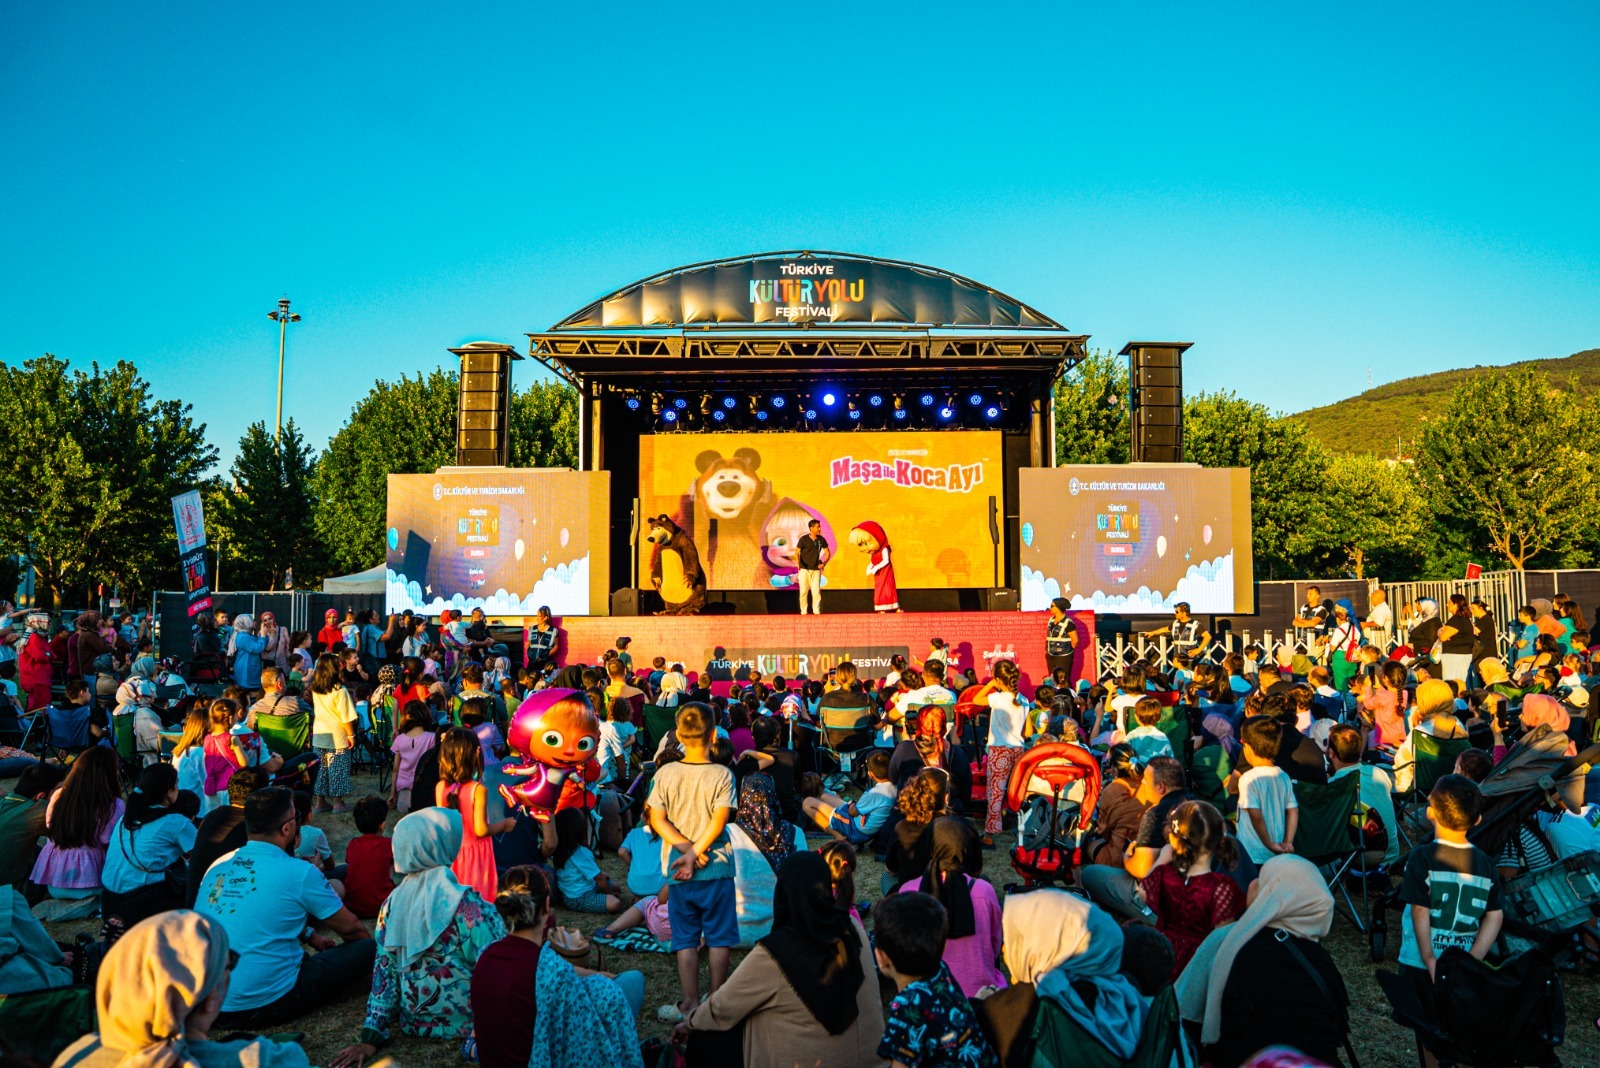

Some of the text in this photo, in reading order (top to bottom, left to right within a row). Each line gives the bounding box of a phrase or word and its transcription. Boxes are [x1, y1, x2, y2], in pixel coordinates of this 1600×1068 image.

[780, 263, 834, 275] TÜRKİYE
[775, 304, 838, 317] FESTİVALİ
[832, 458, 981, 491] Maşa ile Koca Ayı
[711, 657, 755, 669] TÜRKİYE
